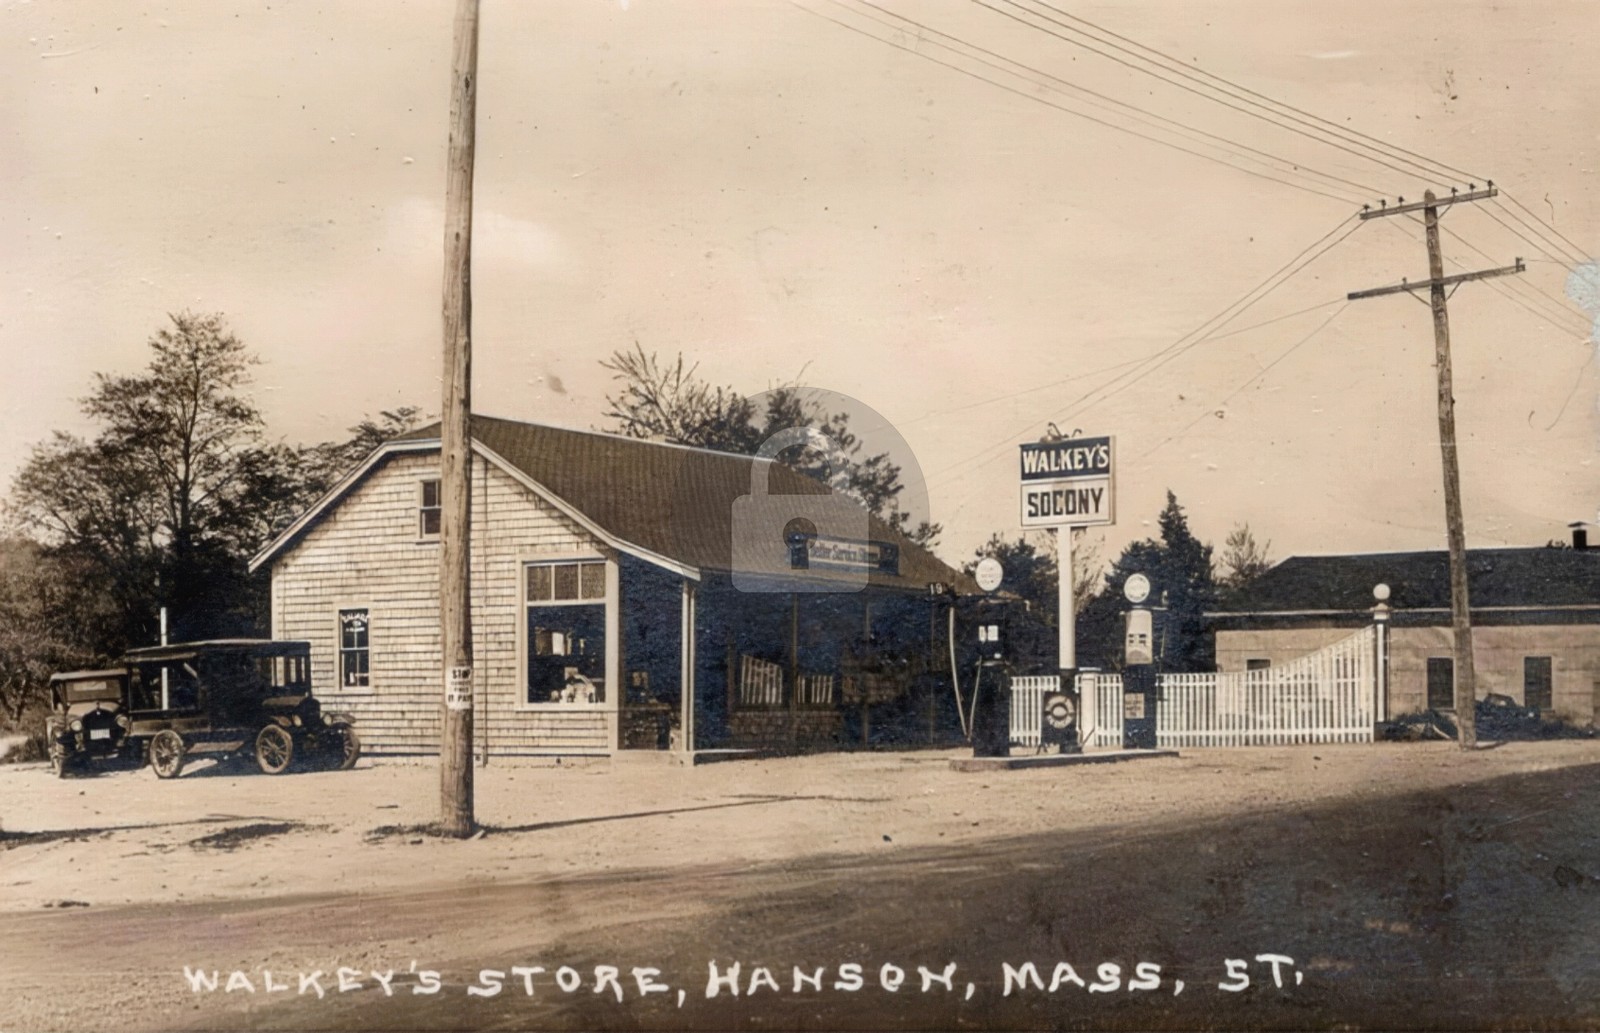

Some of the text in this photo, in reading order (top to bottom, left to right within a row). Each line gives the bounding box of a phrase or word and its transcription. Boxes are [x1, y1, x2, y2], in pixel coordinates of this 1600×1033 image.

[1022, 442, 1109, 474] WALKEY'S
[1027, 487, 1104, 517] SOCONY
[930, 582, 943, 595] 19
